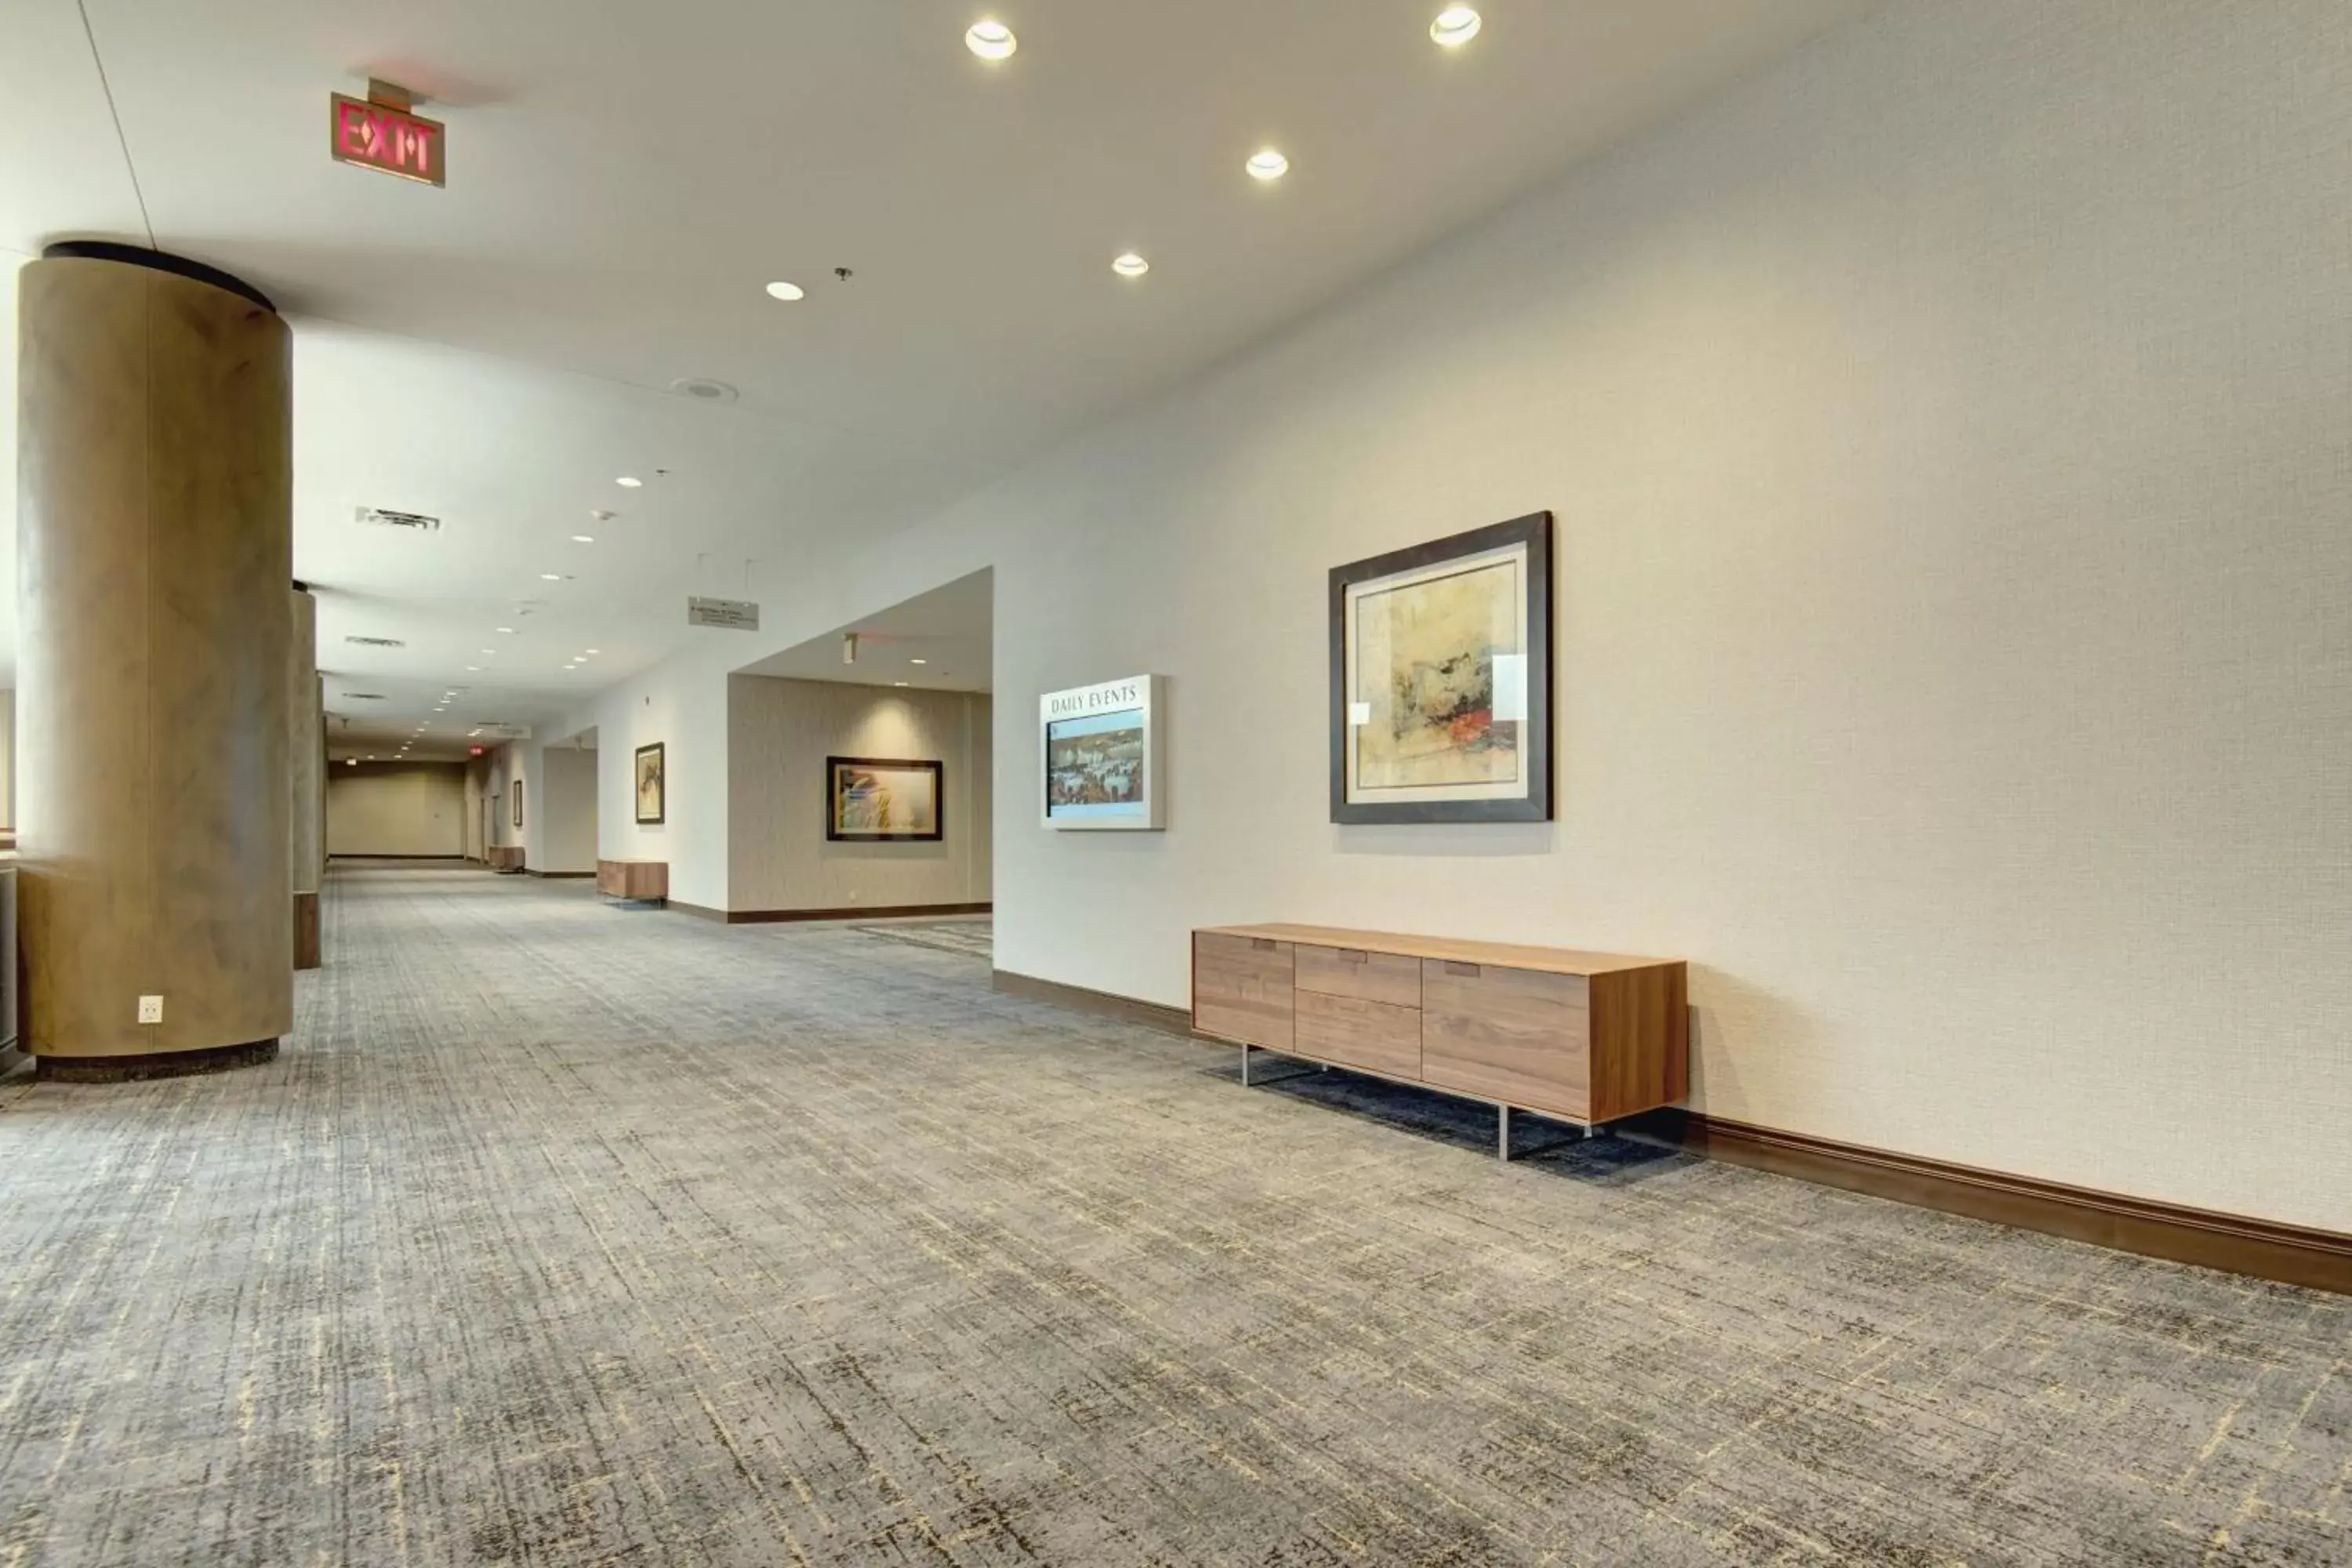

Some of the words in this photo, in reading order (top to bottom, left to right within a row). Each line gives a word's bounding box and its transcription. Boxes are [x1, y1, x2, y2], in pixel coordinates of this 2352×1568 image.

[339, 101, 437, 172] EXIT
[1051, 695, 1084, 714] DAILY
[1089, 684, 1136, 708] EVENTS
